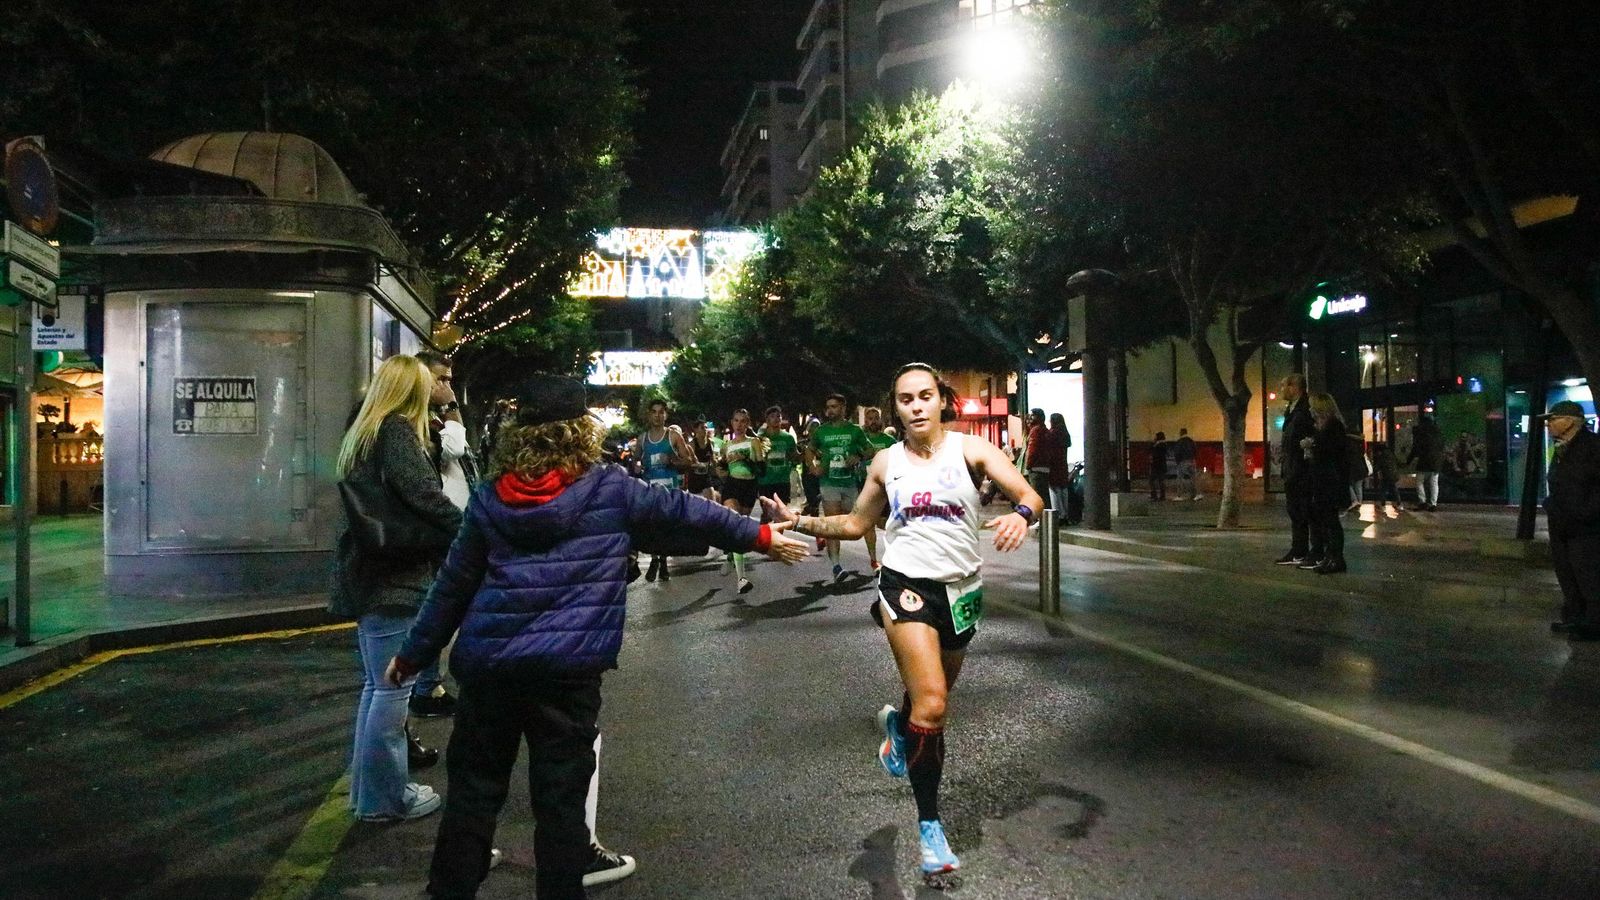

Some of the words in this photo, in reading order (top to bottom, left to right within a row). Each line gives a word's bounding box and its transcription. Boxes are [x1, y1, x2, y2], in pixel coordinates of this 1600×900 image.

[176, 382, 193, 399] SE
[196, 382, 254, 399] ALQUILA
[911, 491, 932, 506] GO
[903, 503, 965, 520] TRAINING
